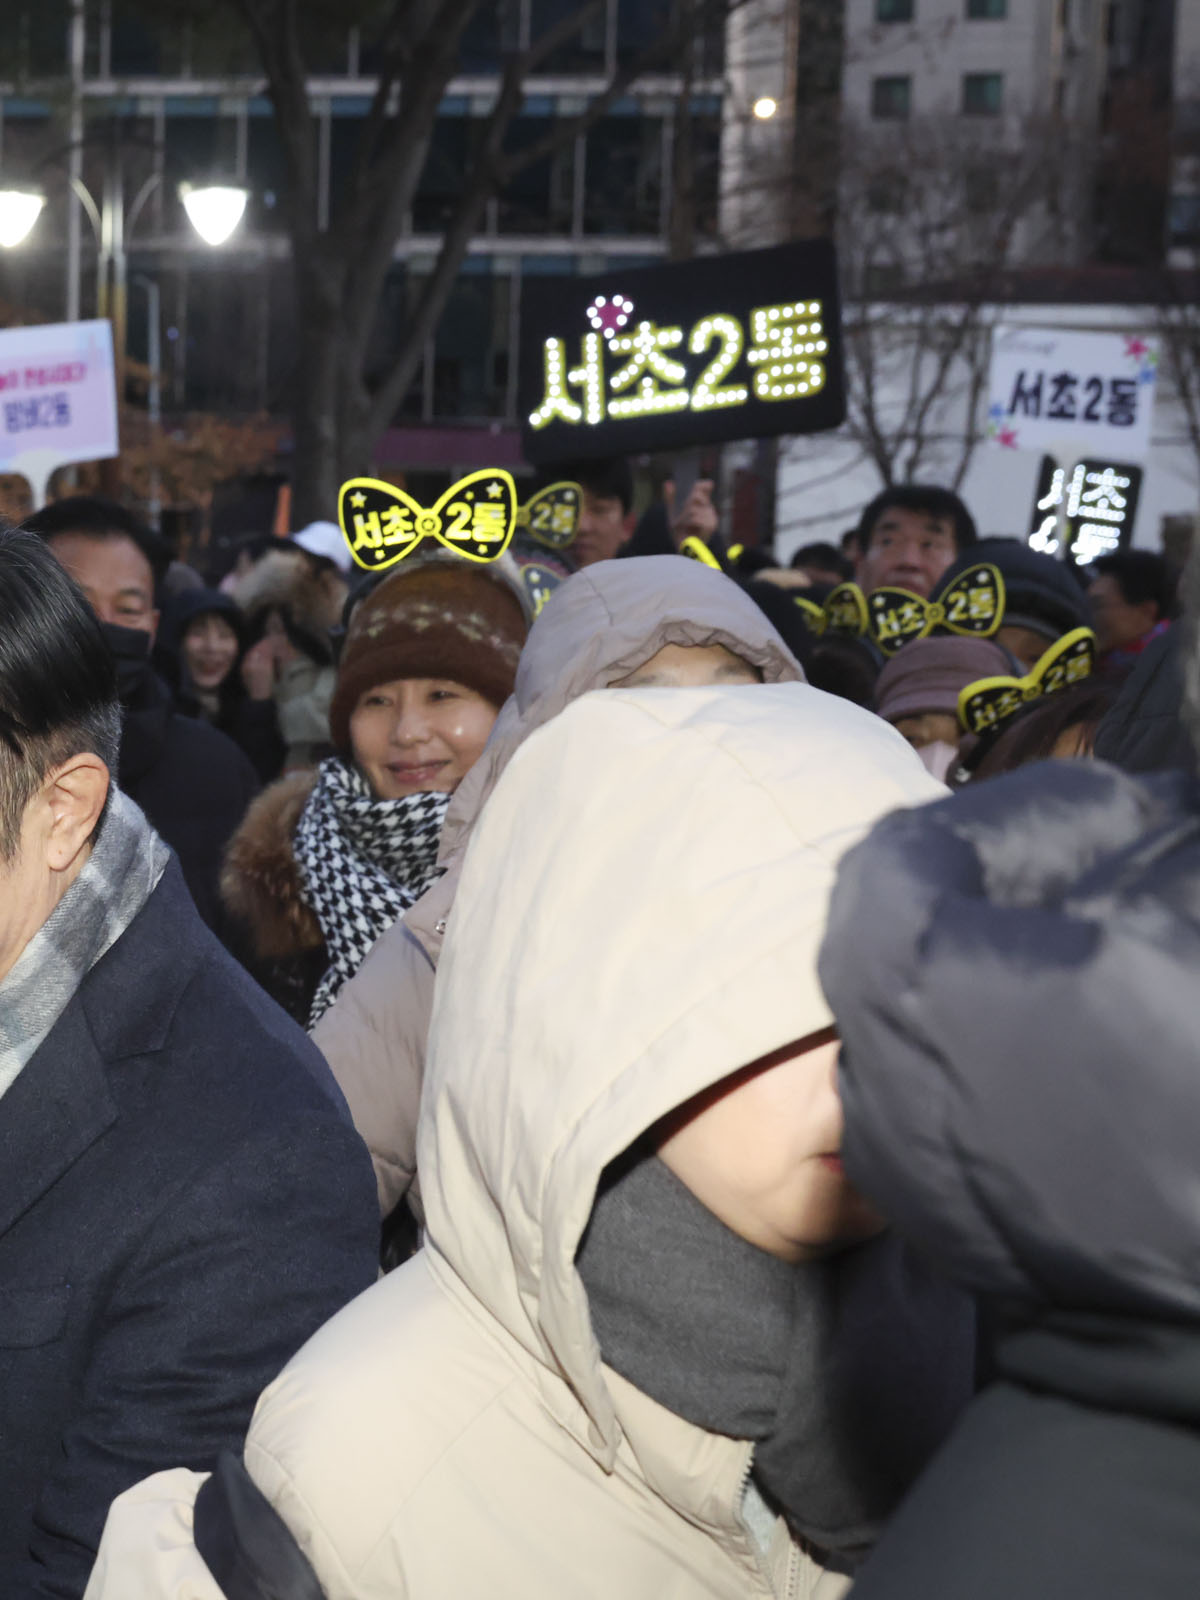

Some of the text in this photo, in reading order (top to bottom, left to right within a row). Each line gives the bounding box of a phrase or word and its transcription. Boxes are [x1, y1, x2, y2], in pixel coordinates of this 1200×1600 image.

[529, 299, 829, 430] 서초2동
[1009, 368, 1138, 427] 서초2동
[353, 501, 507, 551] 서초 2동
